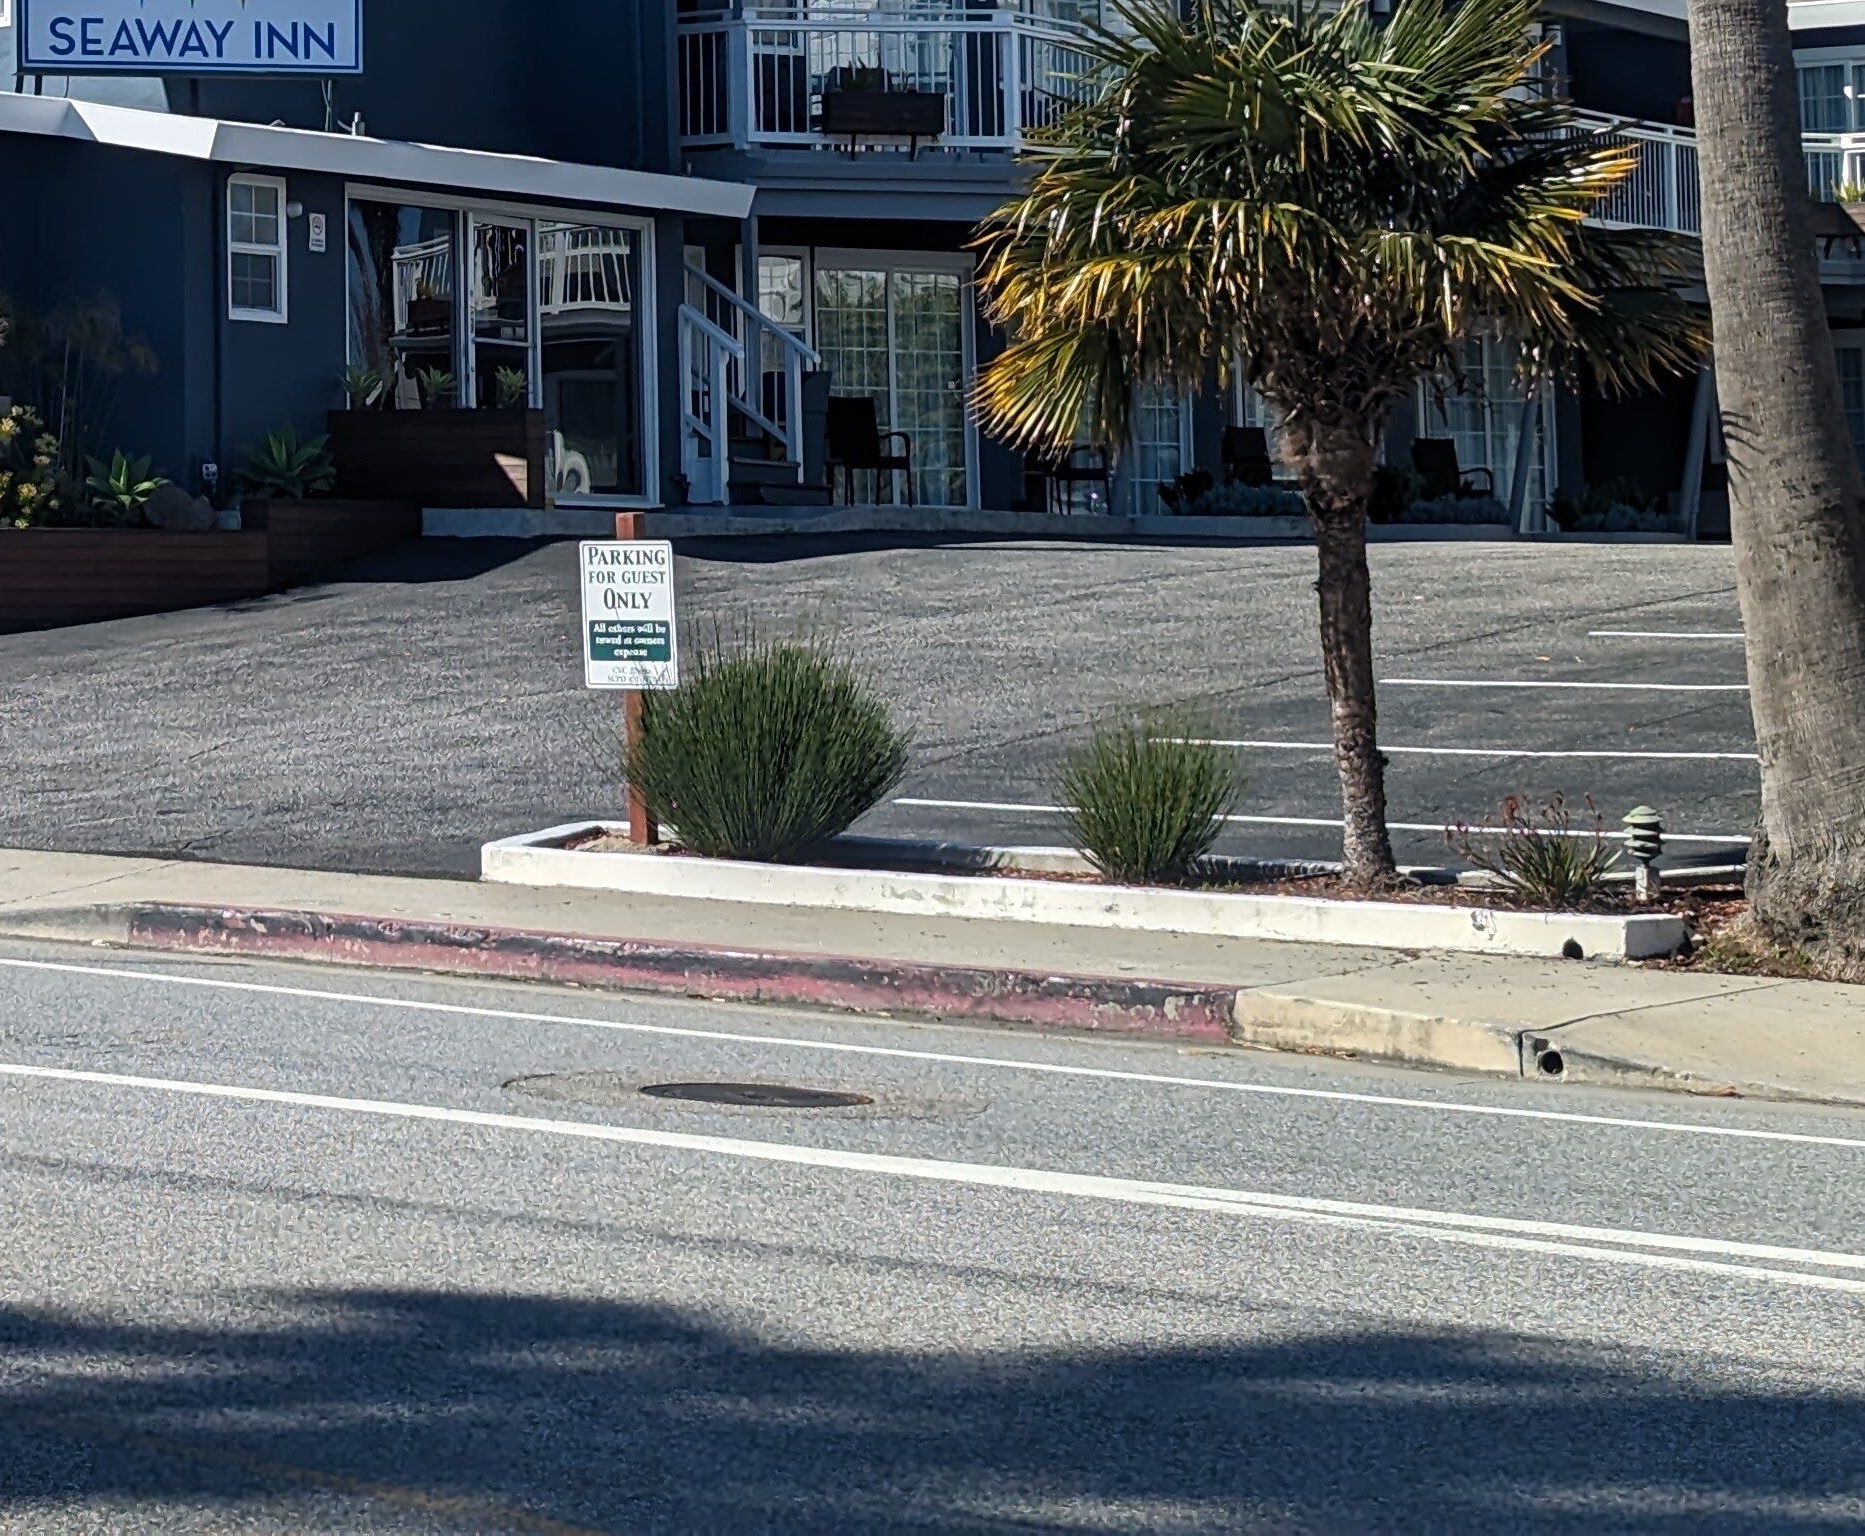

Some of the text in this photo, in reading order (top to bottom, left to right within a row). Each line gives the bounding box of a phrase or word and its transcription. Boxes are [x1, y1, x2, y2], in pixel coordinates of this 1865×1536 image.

[48, 16, 335, 59] SEAWAY INN
[588, 546, 666, 566] PARKING
[588, 570, 666, 584] FOR GUEST
[603, 587, 652, 610] ONLY
[593, 623, 606, 633] All
[637, 623, 654, 633] will
